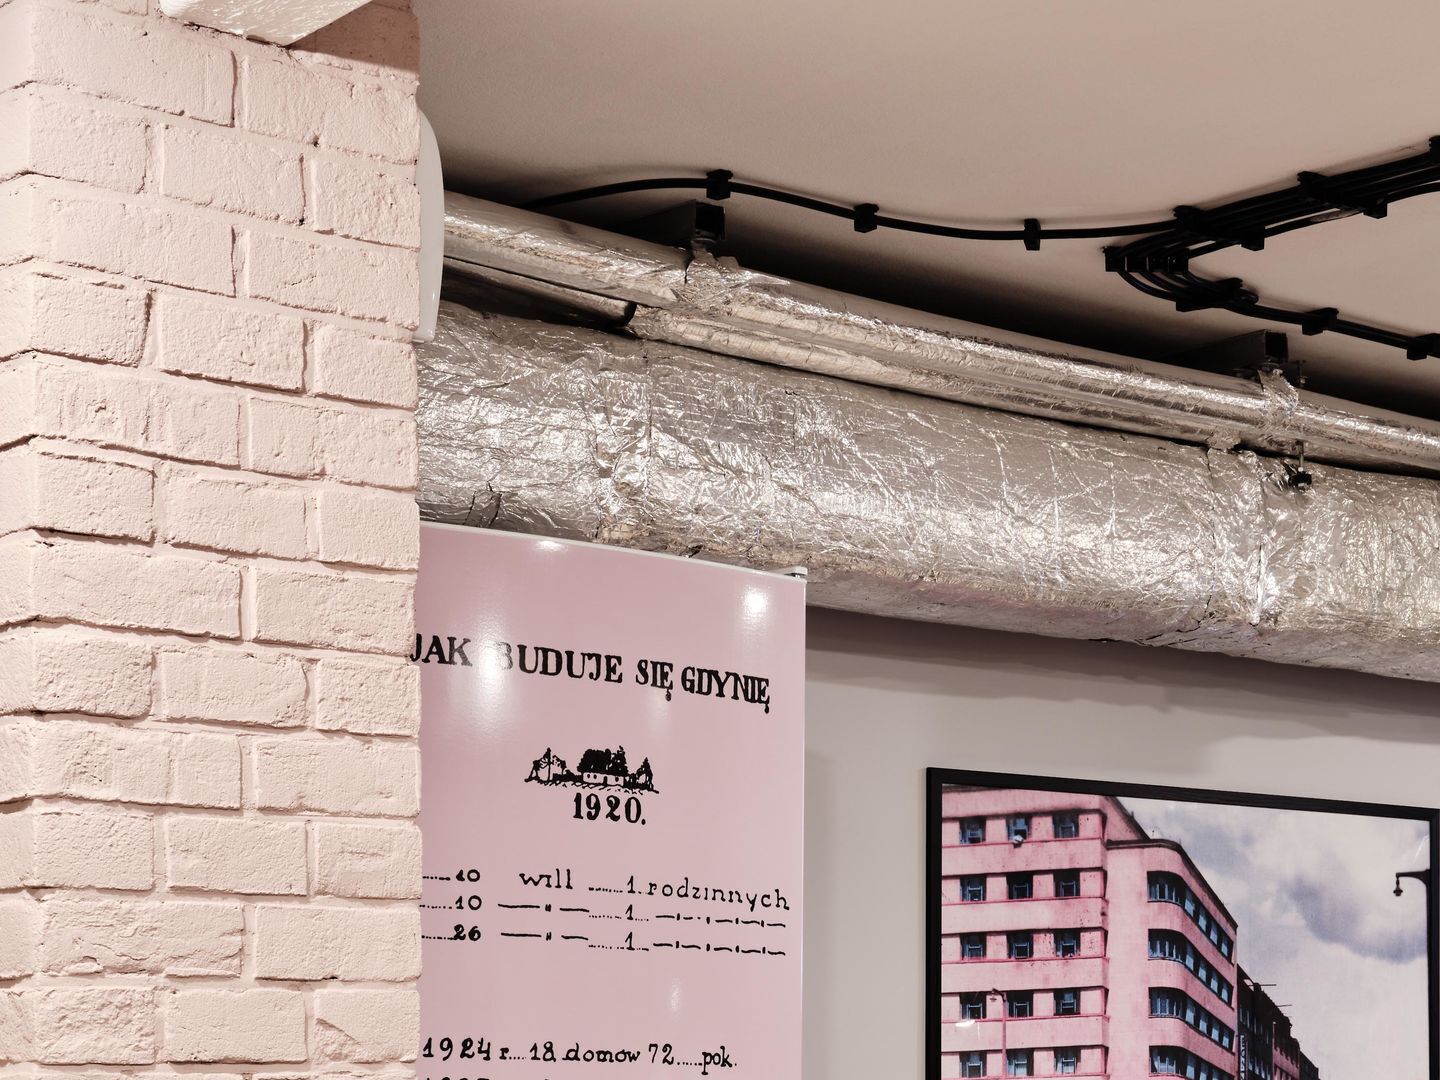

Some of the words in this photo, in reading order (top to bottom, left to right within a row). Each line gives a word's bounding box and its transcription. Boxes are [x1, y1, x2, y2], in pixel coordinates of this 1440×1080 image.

[409, 633, 472, 667] JAK
[495, 641, 623, 684] BUDUJE
[635, 659, 674, 701] SIĘ
[681, 667, 771, 714] GDYNIĘ
[573, 792, 647, 826] 1920.
[455, 895, 482, 911] 10
[518, 868, 574, 890] will
[649, 876, 790, 913] rodzinnych
[453, 924, 482, 942] 26
[422, 1037, 492, 1062] 1924
[529, 1040, 557, 1063] 18
[648, 1043, 675, 1066] 72
